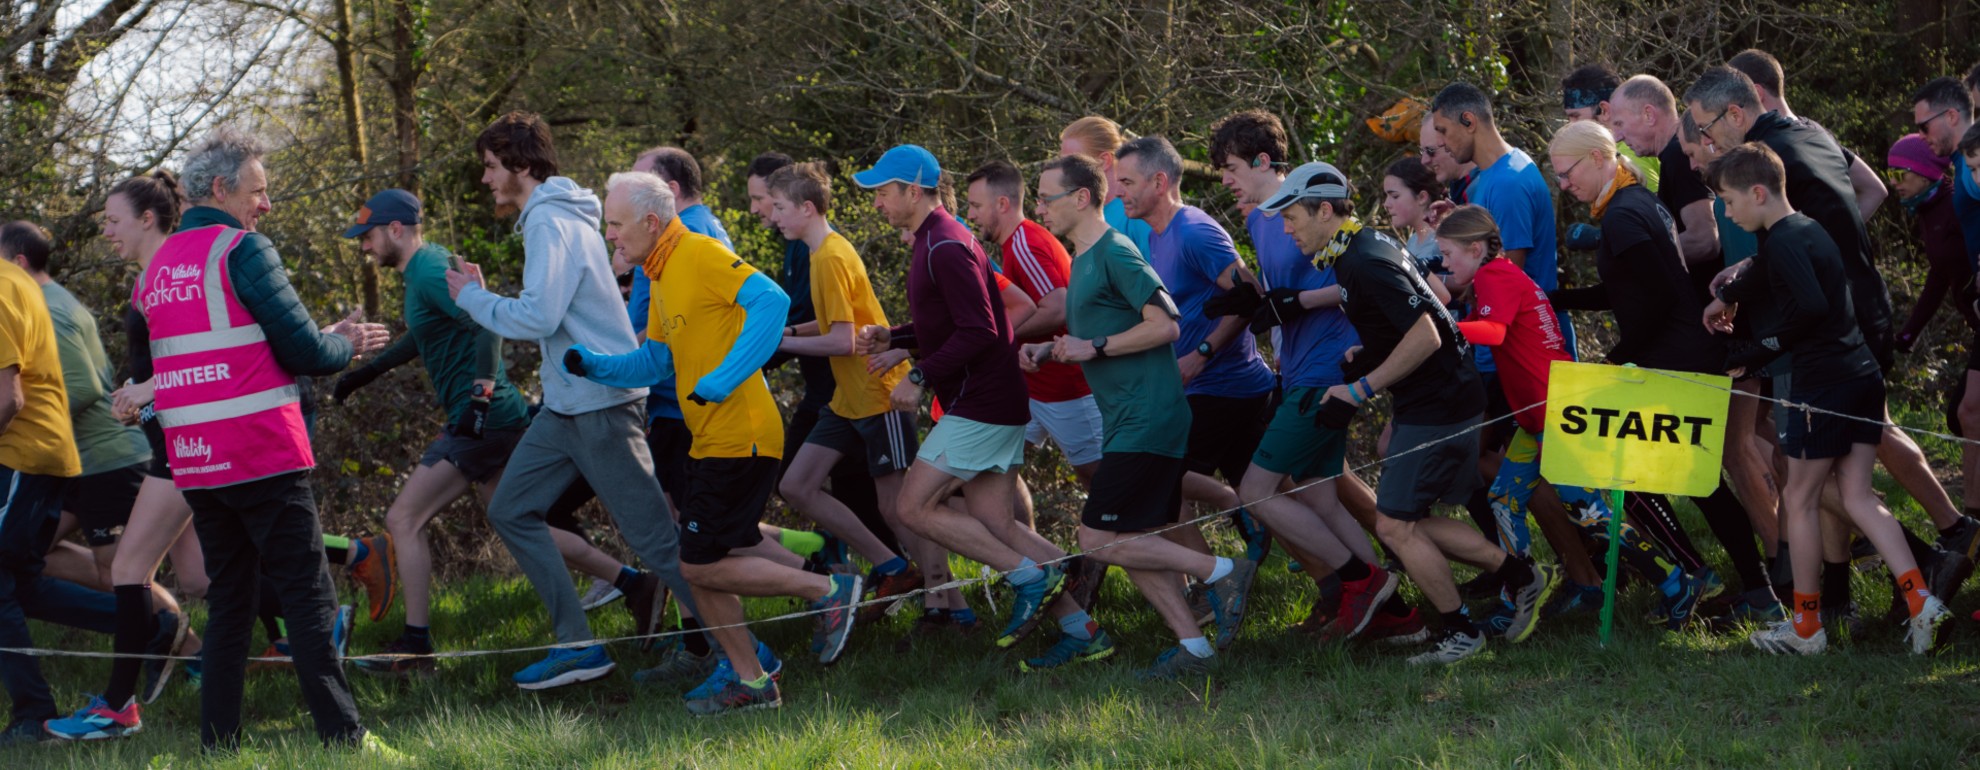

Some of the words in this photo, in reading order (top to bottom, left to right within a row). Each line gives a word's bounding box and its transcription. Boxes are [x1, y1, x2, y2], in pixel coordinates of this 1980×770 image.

[172, 263, 201, 281] Vitality
[154, 363, 231, 390] OLUNTEER
[1560, 405, 1713, 446] START
[173, 434, 212, 463] Vitality
